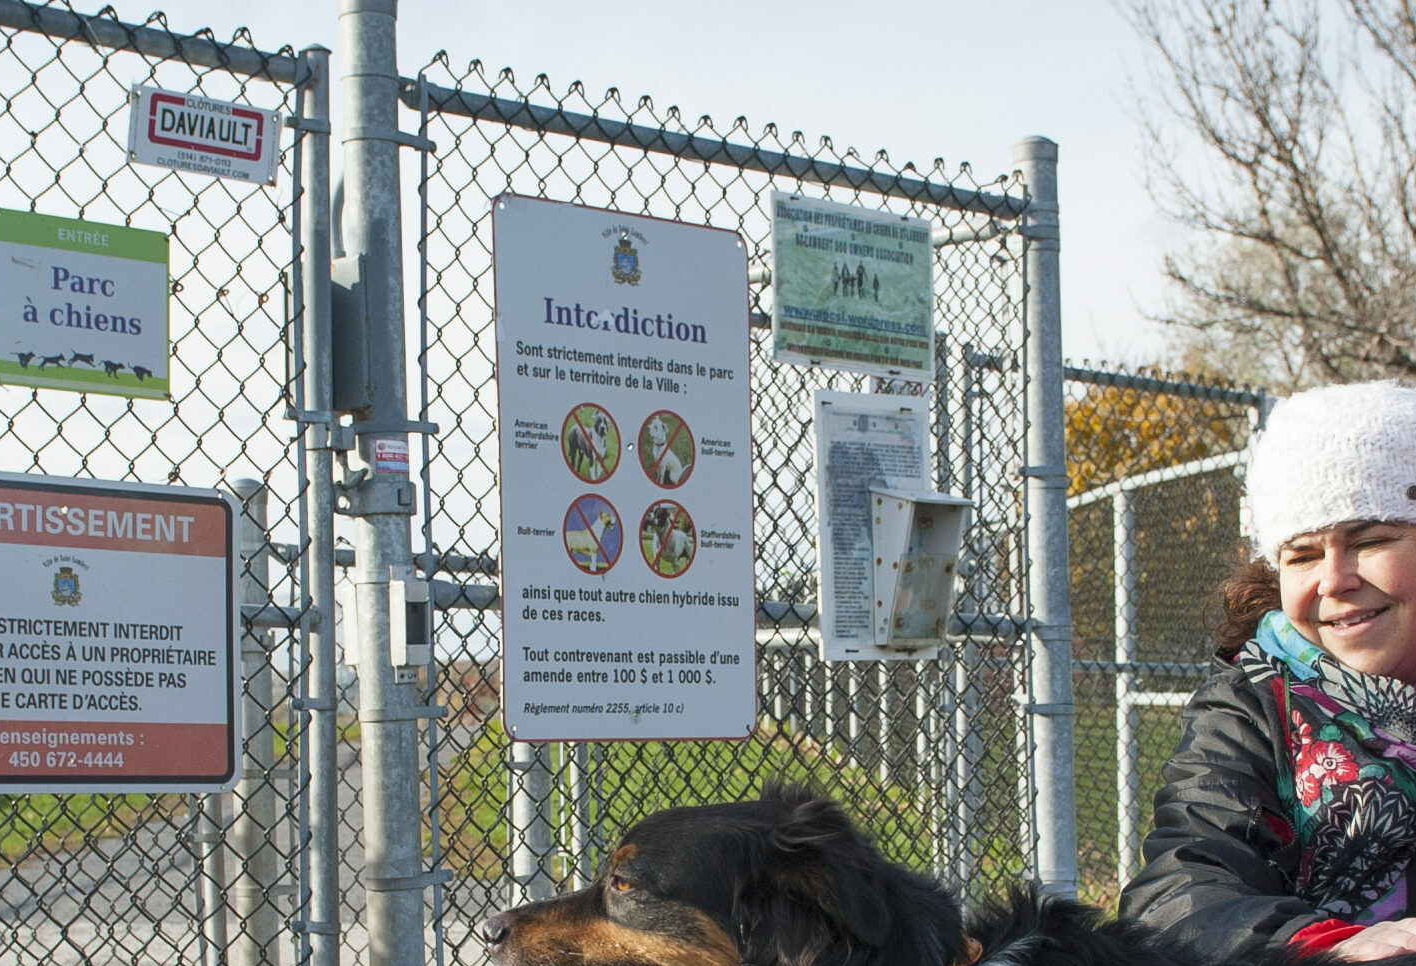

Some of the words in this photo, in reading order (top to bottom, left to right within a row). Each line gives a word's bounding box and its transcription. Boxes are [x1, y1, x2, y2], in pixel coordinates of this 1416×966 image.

[186, 98, 231, 115] CLÔTURES
[160, 108, 253, 147] DAVIAULT
[177, 151, 197, 162] (514)
[57, 227, 109, 247] ENTRÉE
[51, 266, 115, 298] Parc
[23, 296, 39, 324] à
[49, 302, 142, 336] chiens
[516, 340, 544, 358] Sont
[546, 345, 615, 365] strictement
[617, 352, 664, 372] interdits
[666, 359, 694, 376] dans
[696, 362, 706, 377] le
[709, 367, 734, 381] parc
[516, 363, 529, 377] et
[532, 366, 552, 379] sur
[555, 365, 566, 381] le
[569, 368, 622, 387] territoire
[624, 373, 639, 389] de
[642, 375, 653, 391] la
[655, 376, 680, 394] Ville
[514, 418, 549, 430] American
[514, 430, 560, 442] staffordshire
[514, 440, 539, 450] terrier
[700, 437, 732, 448] American
[701, 447, 736, 458] bull-terrier
[517, 526, 556, 537] Bull-terrier
[700, 529, 742, 541] Staffordshire
[700, 539, 735, 549] bull-terrier
[522, 584, 551, 600] ainsi
[553, 589, 576, 604] que
[578, 587, 603, 602] tout
[605, 589, 636, 604] autre
[638, 589, 670, 604] chien
[672, 590, 715, 609] hybride
[717, 592, 739, 607] issu
[522, 604, 538, 620] de
[541, 609, 563, 621] ces
[567, 610, 605, 623] races.
[113, 622, 184, 642] INTERDIT
[7, 639, 61, 661] ACCÈS
[65, 641, 77, 662] À
[81, 645, 106, 663] UN
[110, 645, 217, 666] PROPRIÉTAIRE
[522, 646, 550, 662] Tout
[553, 649, 633, 664] contrevenant
[637, 650, 655, 664] est
[658, 650, 706, 667] passible
[709, 650, 740, 665] d'une
[21, 667, 51, 685] QUI
[55, 668, 78, 686] NE
[82, 667, 154, 688] POSSÈDE
[158, 672, 187, 689] PAS
[523, 667, 573, 683] amende
[576, 669, 609, 683] entre
[613, 668, 636, 684] 100
[640, 667, 648, 685] $
[651, 670, 664, 684] et
[667, 669, 674, 684] 1
[678, 669, 702, 684] 000
[705, 668, 716, 685] $.
[15, 692, 68, 710] CARTE
[72, 692, 142, 712] D'ACCÈS.
[523, 702, 570, 716] Règlement
[571, 703, 604, 714] numéro
[605, 702, 632, 715] 2255,
[633, 703, 660, 716] article
[662, 702, 674, 714] 10
[8, 751, 41, 768] 450
[46, 751, 125, 768] 672-4444
